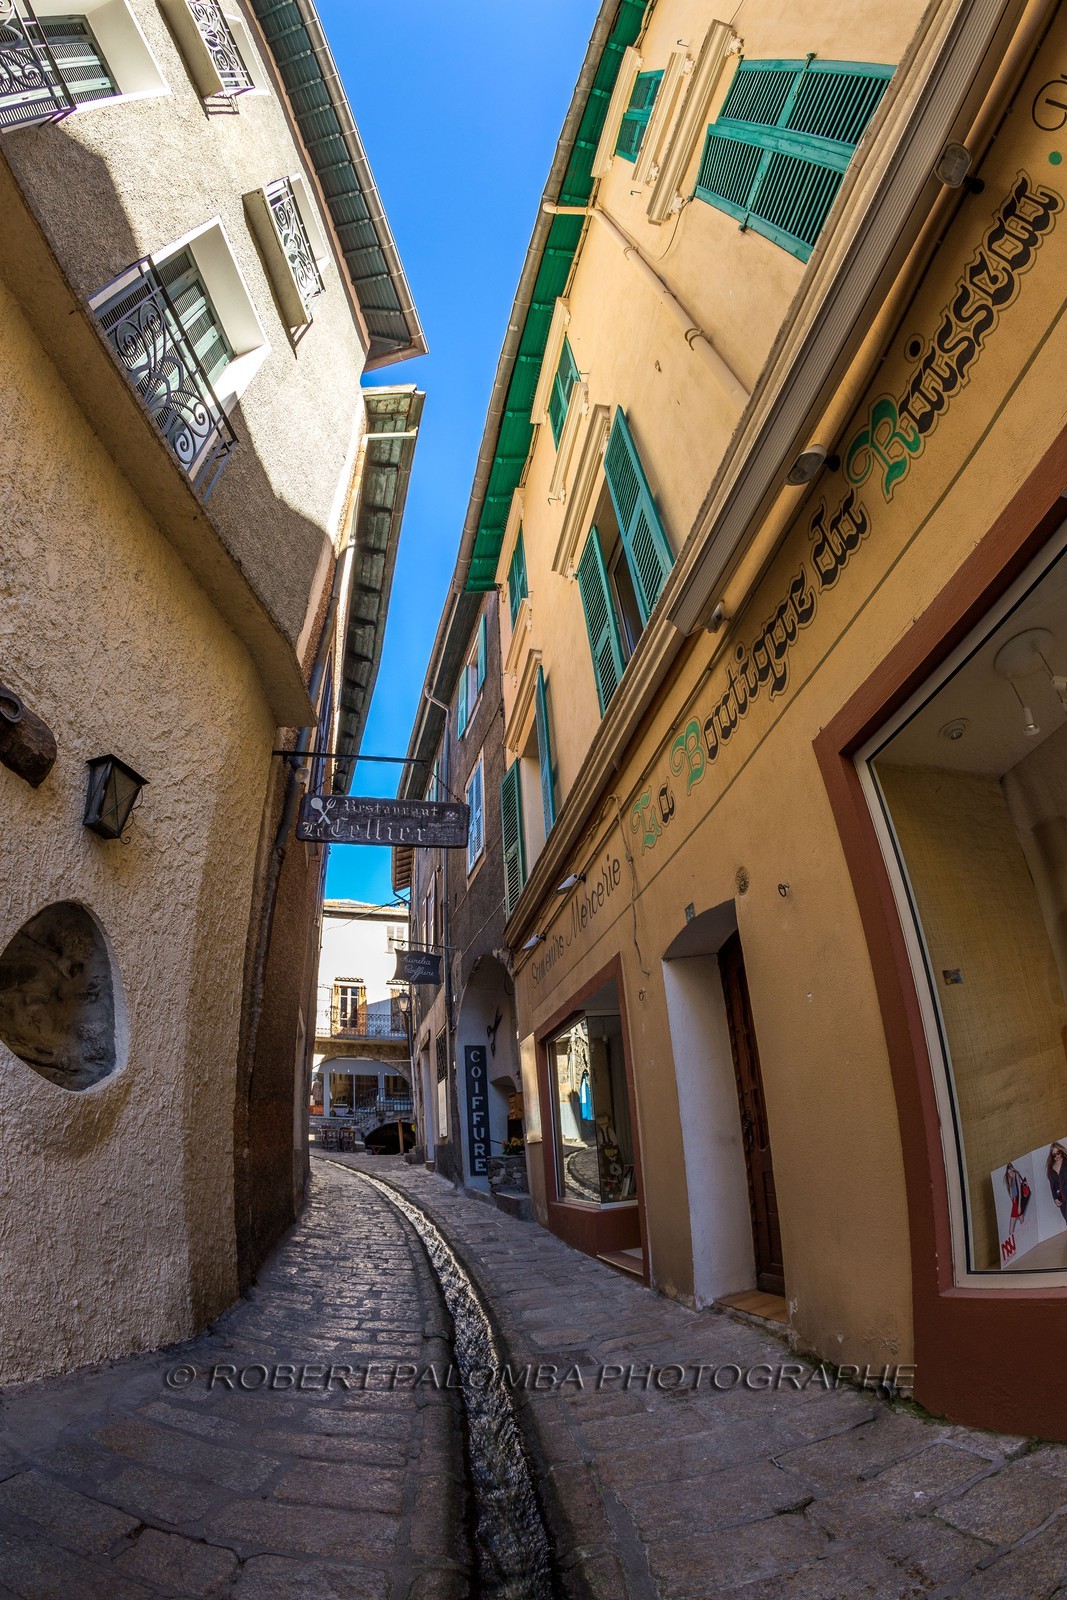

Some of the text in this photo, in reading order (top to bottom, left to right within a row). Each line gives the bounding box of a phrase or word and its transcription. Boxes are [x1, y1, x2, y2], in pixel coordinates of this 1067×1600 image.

[630, 169, 1065, 855] La Boutique du Ruisseau
[303, 816, 428, 842] Le Cellier
[344, 799, 438, 817] Restaurant
[566, 853, 622, 947] Mercerie
[470, 1050, 487, 1172] COIFFURE
